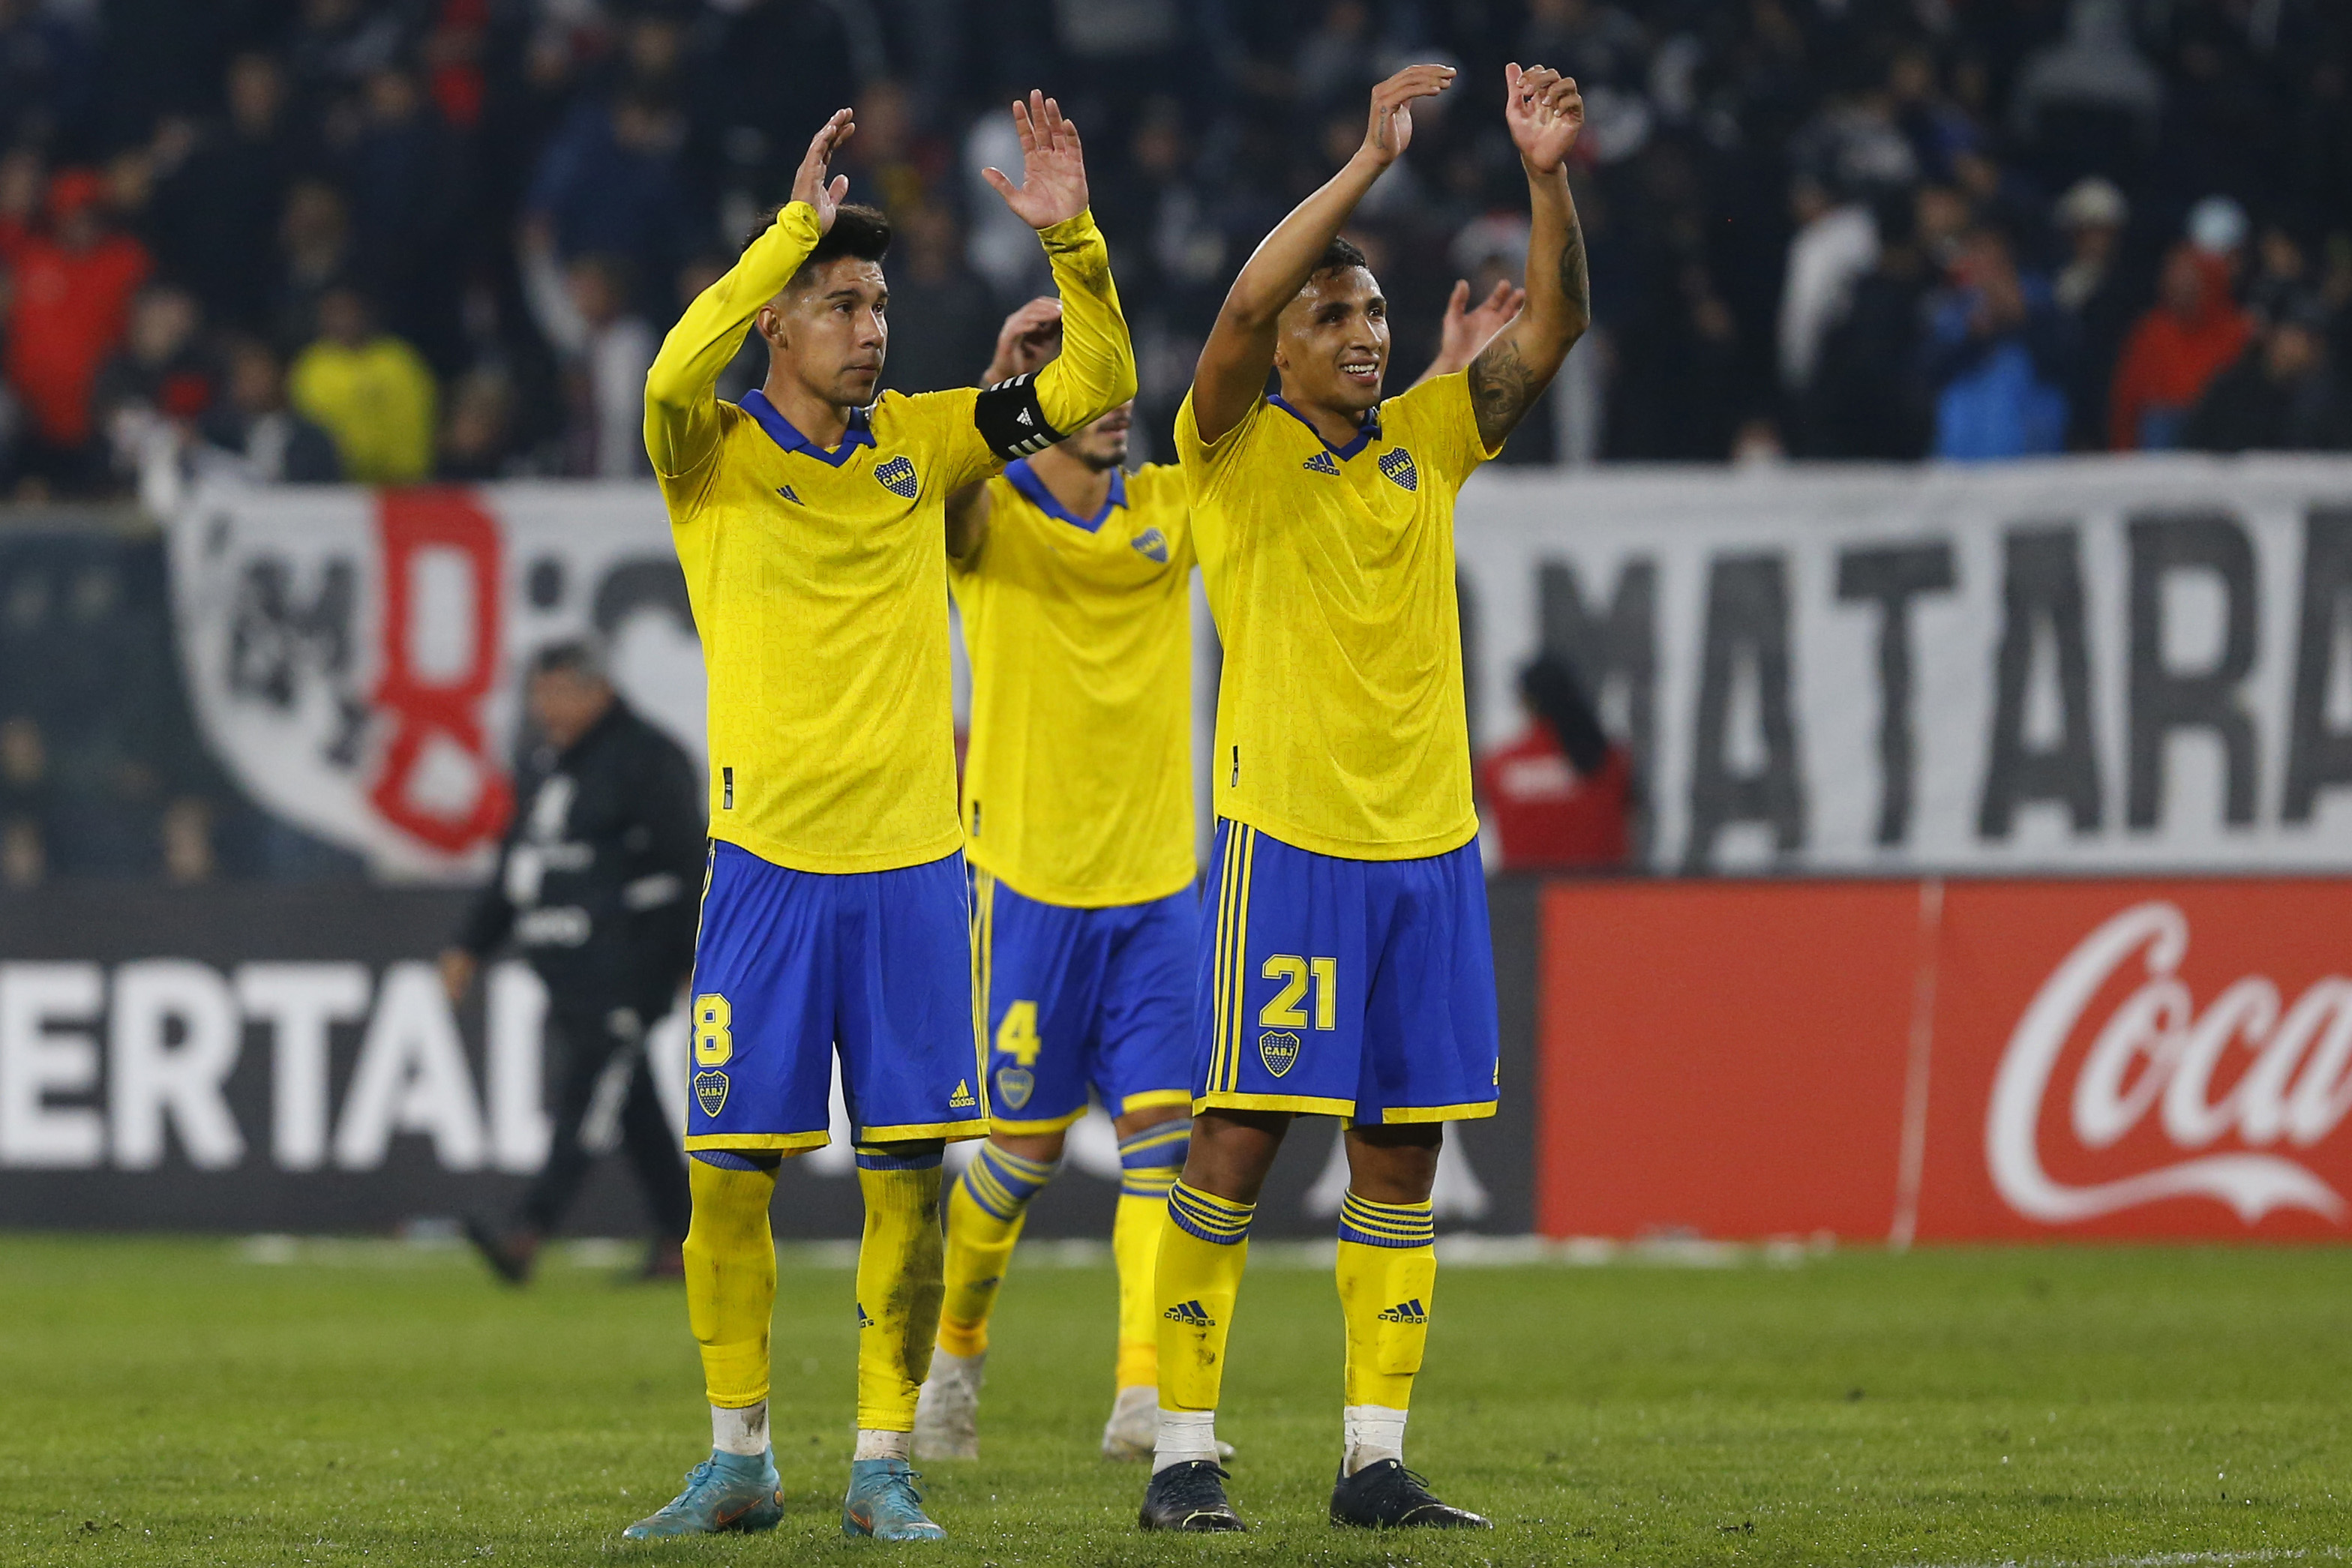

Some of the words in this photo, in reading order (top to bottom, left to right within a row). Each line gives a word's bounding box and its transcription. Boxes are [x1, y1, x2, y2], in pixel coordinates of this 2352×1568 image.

[882, 466, 914, 487] CABJ
[1302, 462, 1341, 477] adidas
[1385, 457, 1414, 478] CABJ
[1258, 953, 1337, 1031] 21
[693, 992, 734, 1068] 8
[996, 998, 1042, 1066] 4
[1264, 1045, 1294, 1057] CABJ
[1984, 900, 2352, 1230] Coca
[698, 1087, 724, 1097] CABJ
[949, 1096, 976, 1108] adidas
[1163, 1310, 1216, 1327] adidas
[1377, 1312, 1429, 1325] adidas
